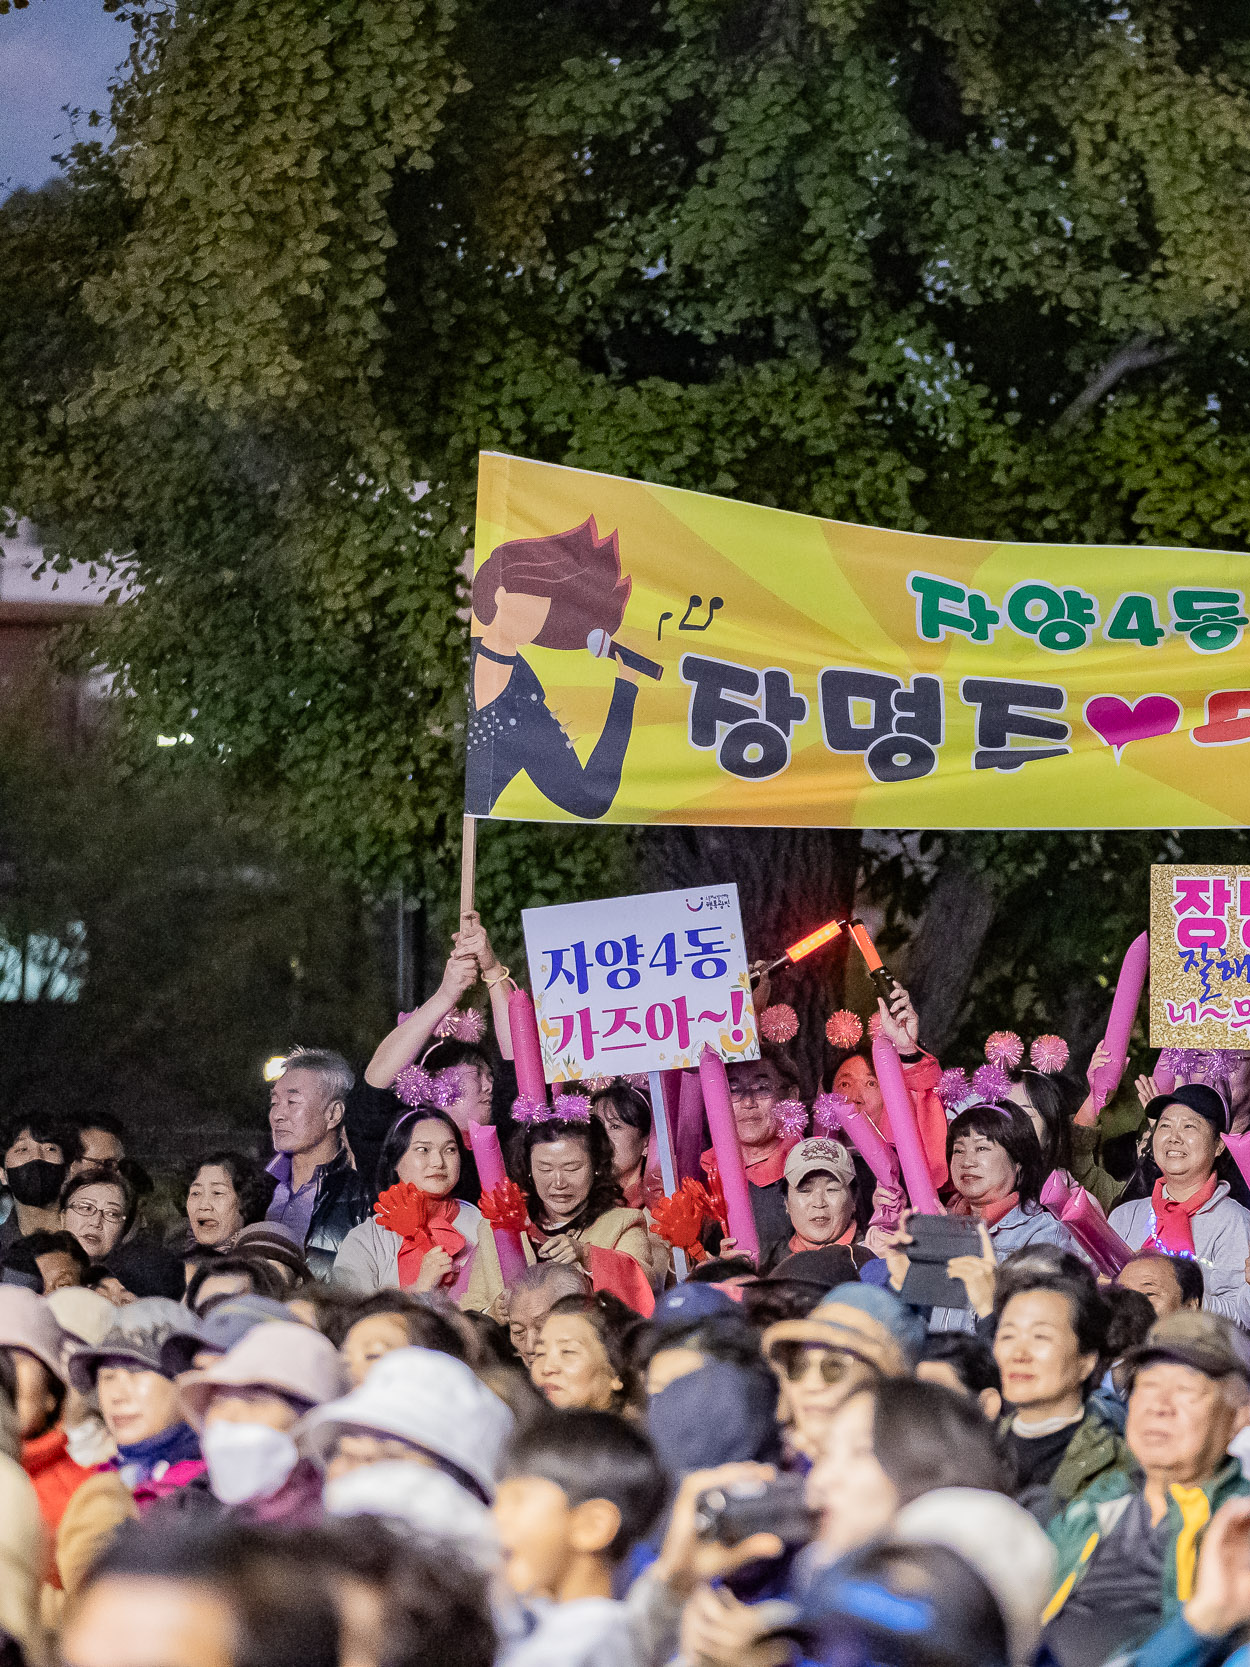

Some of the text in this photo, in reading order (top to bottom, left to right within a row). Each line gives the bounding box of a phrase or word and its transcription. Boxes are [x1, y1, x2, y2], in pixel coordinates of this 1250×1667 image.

[907, 570, 1249, 653] 자양4동
[542, 926, 731, 994] 자양4동
[549, 991, 744, 1060] 가즈아~!
